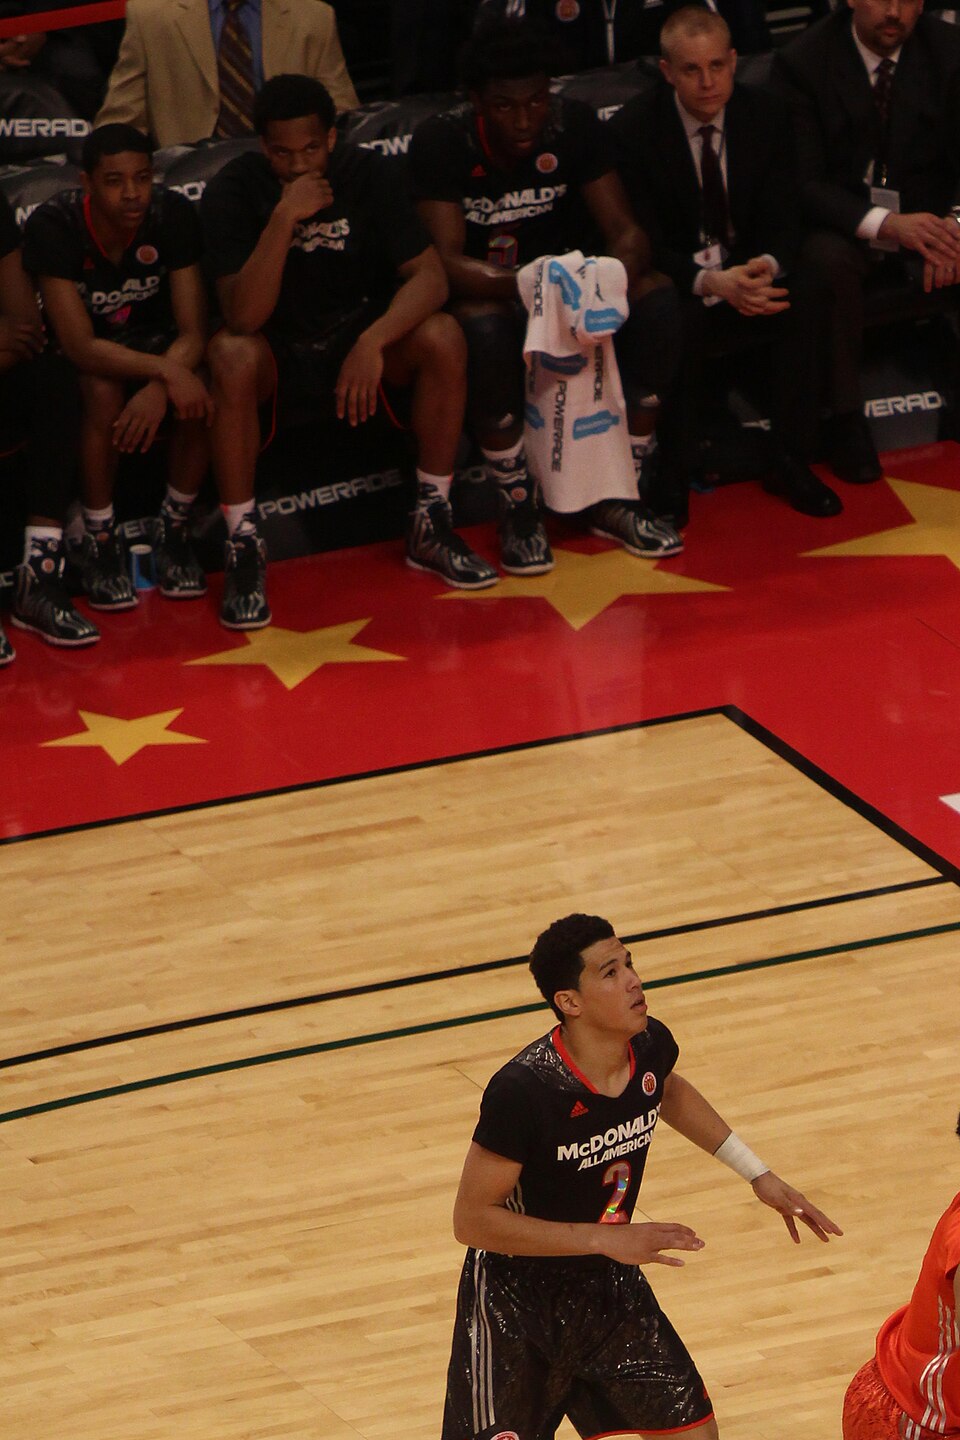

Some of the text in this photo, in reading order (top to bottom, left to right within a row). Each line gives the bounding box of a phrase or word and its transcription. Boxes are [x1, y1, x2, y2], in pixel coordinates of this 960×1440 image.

[551, 379, 568, 473] POWERADE
[256, 467, 403, 521] POWERADE
[600, 1158, 633, 1225] 2
